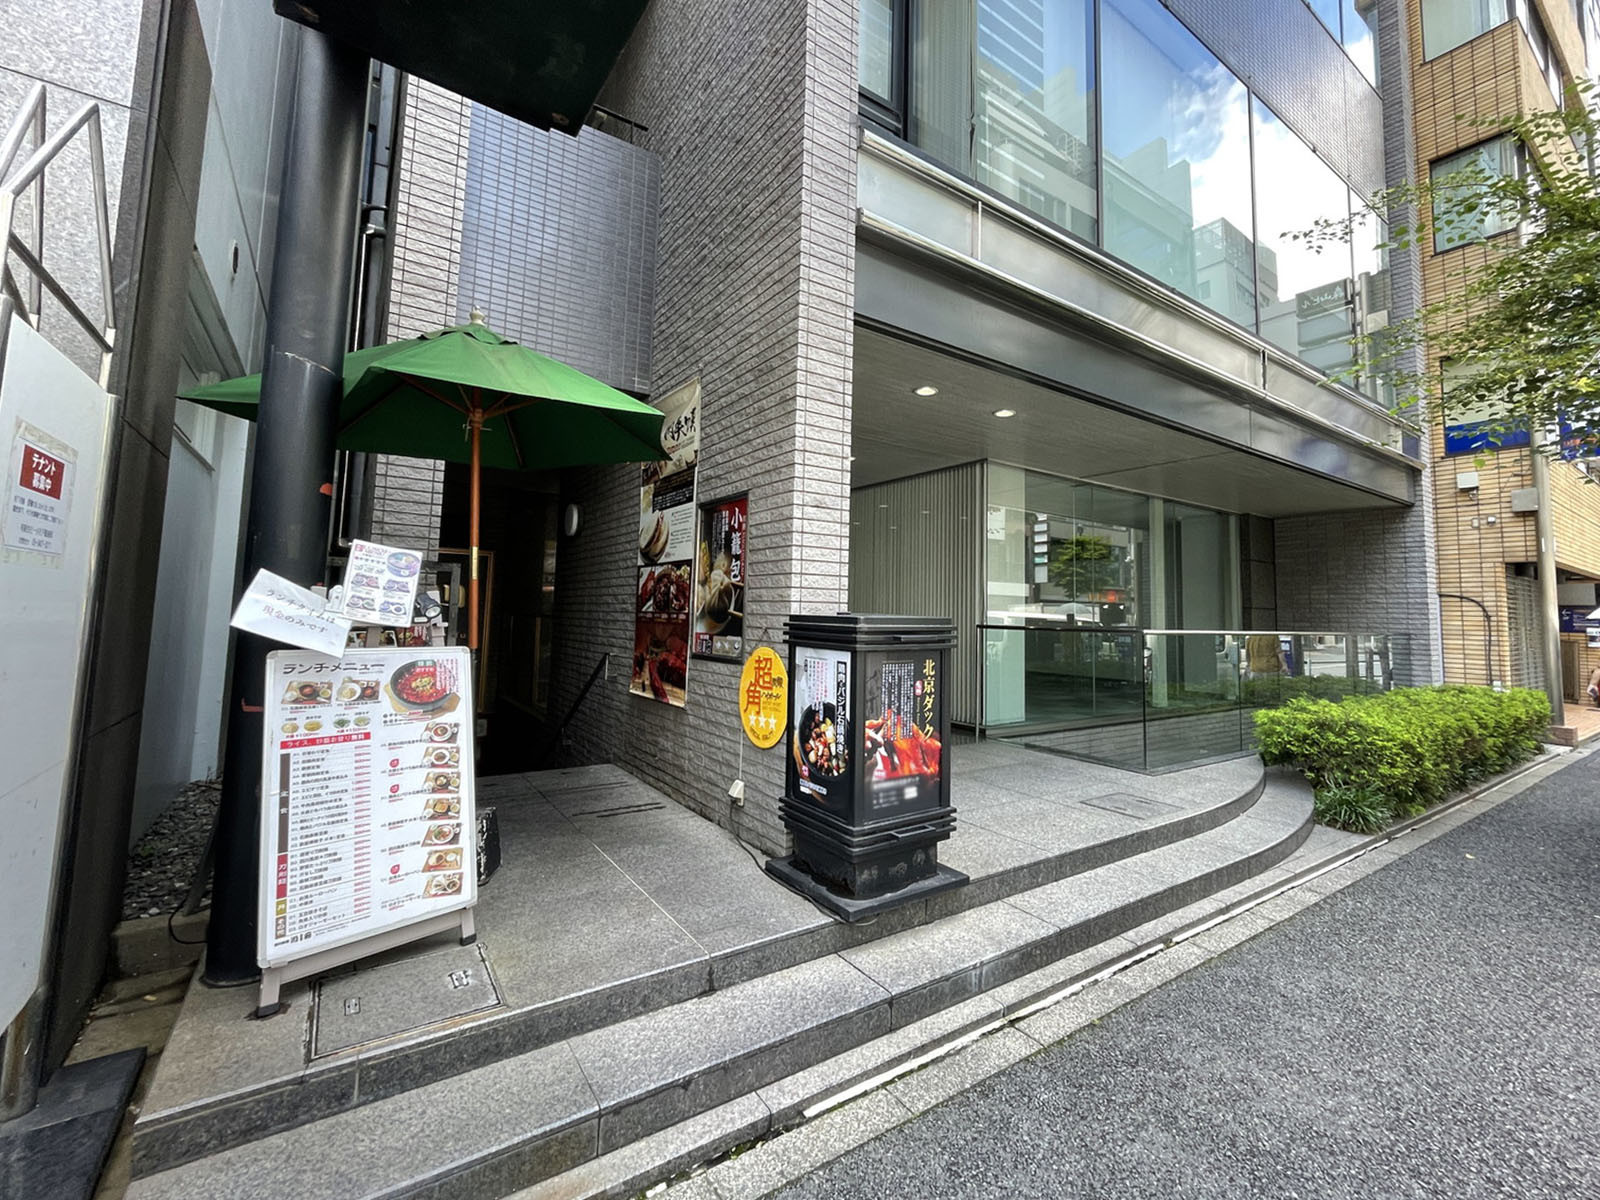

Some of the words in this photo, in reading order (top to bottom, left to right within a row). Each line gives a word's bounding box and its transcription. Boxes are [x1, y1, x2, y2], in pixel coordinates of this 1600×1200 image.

[32, 453, 56, 475] テナント
[32, 472, 52, 491] 募集中
[730, 507, 743, 581] 小籠包
[262, 604, 329, 633] 現金のみです
[266, 588, 336, 624] ランチタイムは
[283, 662, 385, 674] ランチメニュー
[744, 655, 773, 714] 超角
[923, 659, 936, 740] 北京ダック
